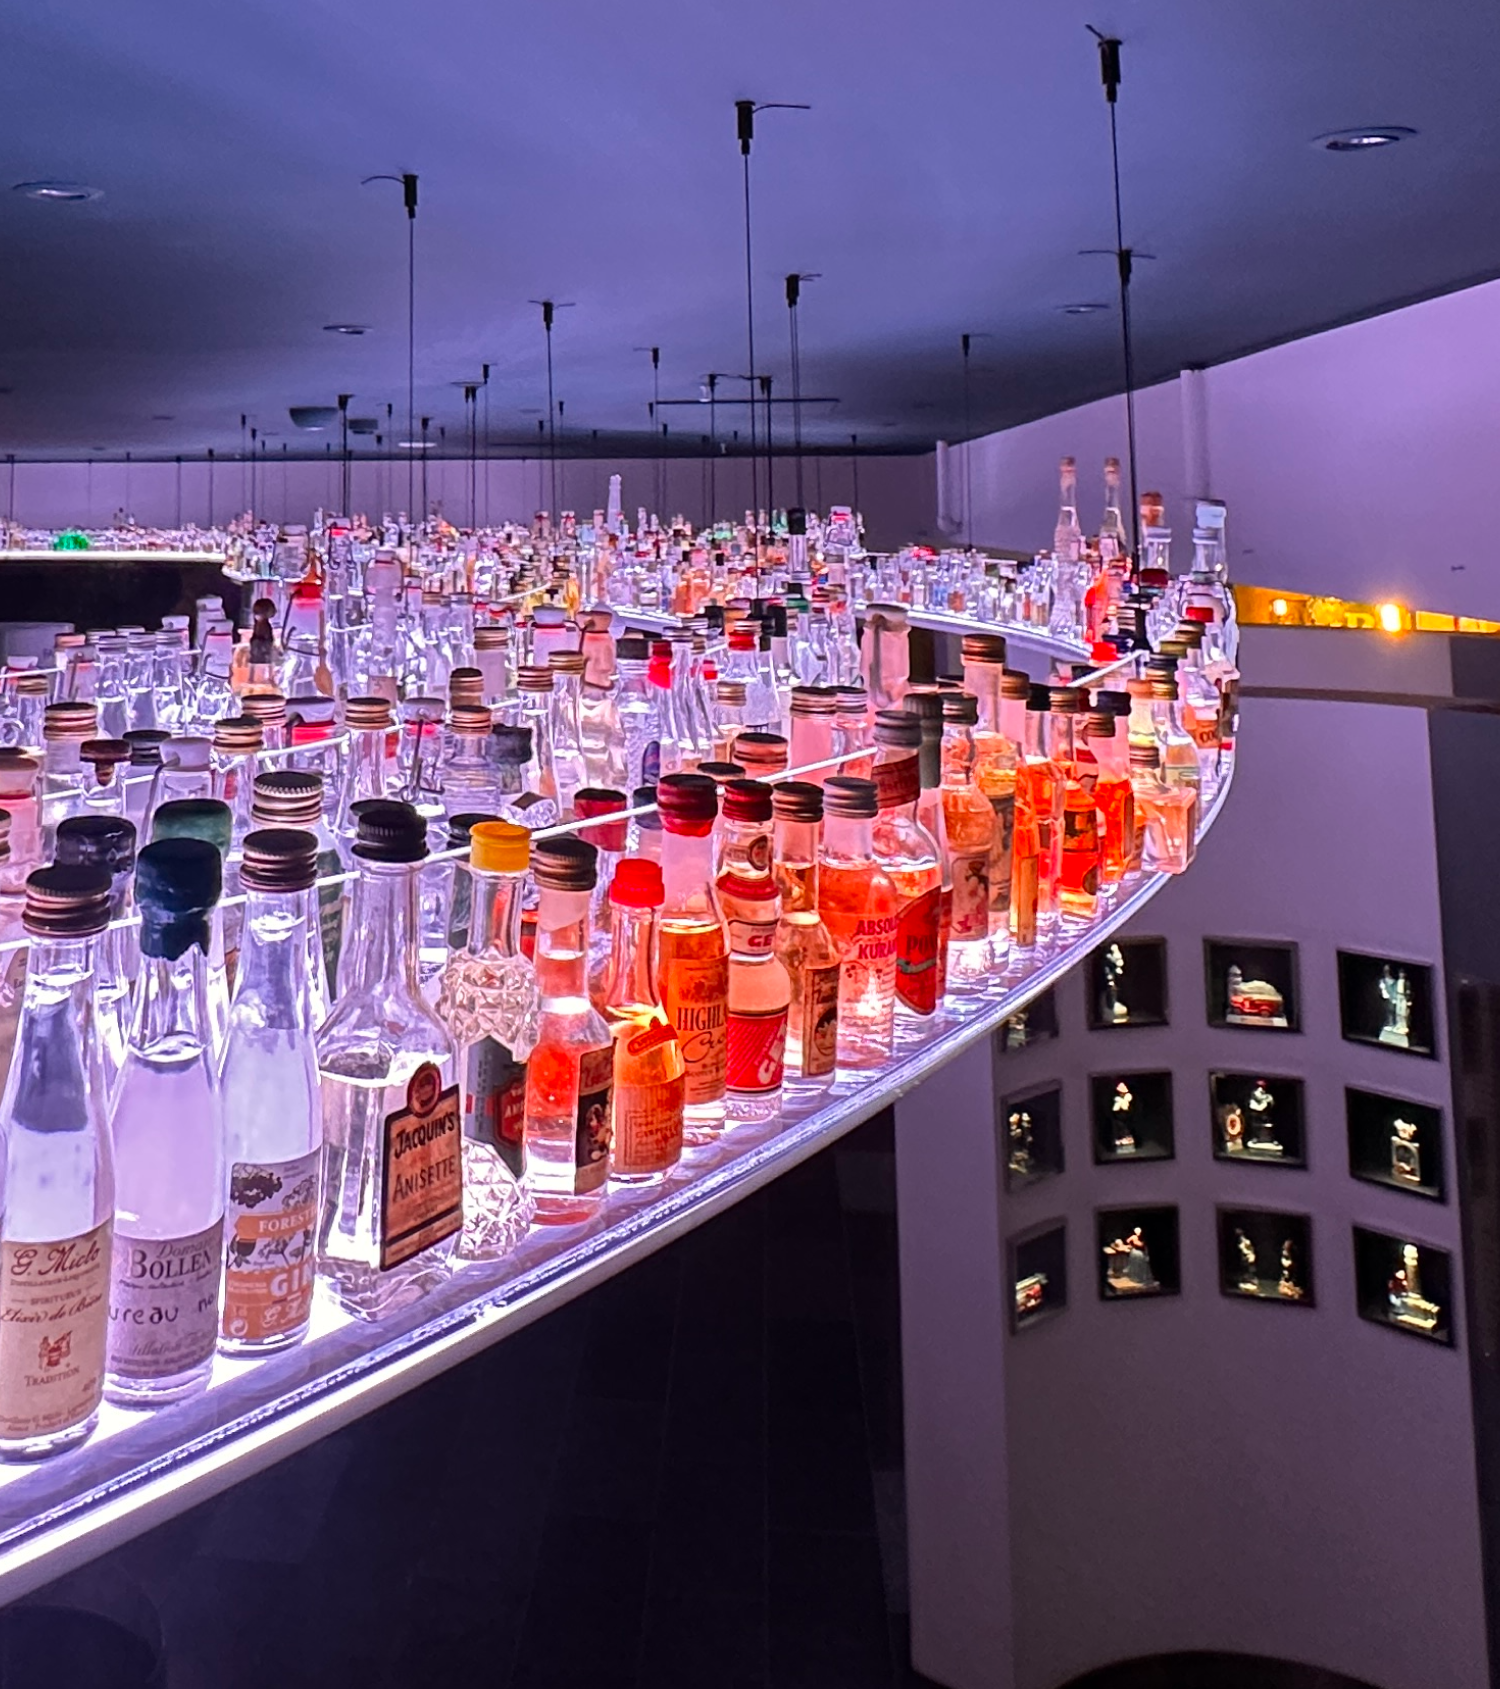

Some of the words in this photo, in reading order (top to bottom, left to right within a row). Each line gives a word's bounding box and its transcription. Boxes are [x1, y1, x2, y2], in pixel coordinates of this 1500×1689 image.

[394, 1111, 455, 1160] JACQUIN'S
[393, 1155, 456, 1203] ANISETTE
[24, 1365, 80, 1387] TRADITION
